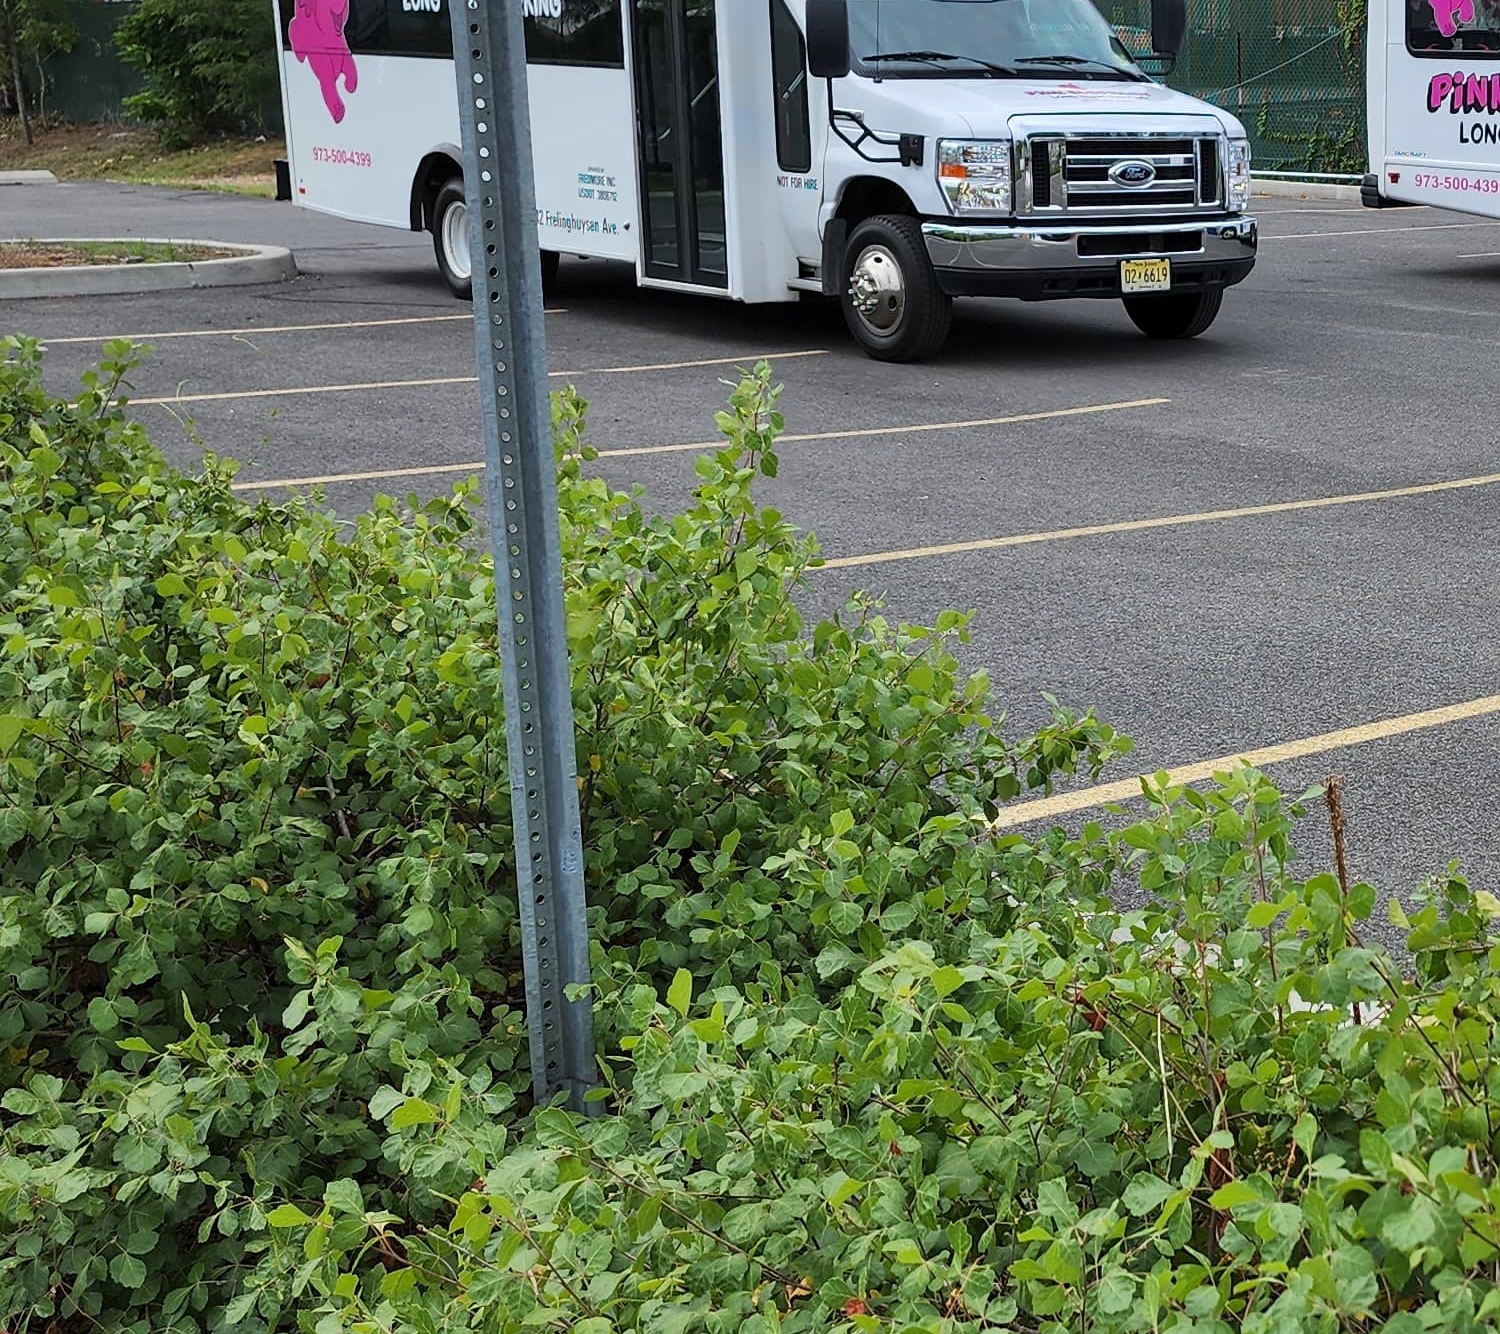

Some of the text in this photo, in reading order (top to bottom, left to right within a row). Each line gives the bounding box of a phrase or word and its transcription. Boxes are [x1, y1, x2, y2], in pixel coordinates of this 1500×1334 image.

[313, 146, 371, 167] 973-500-4399
[1125, 167, 1146, 178] Ford
[545, 210, 599, 234] Frelinghuysen
[602, 218, 620, 235] Ave.
